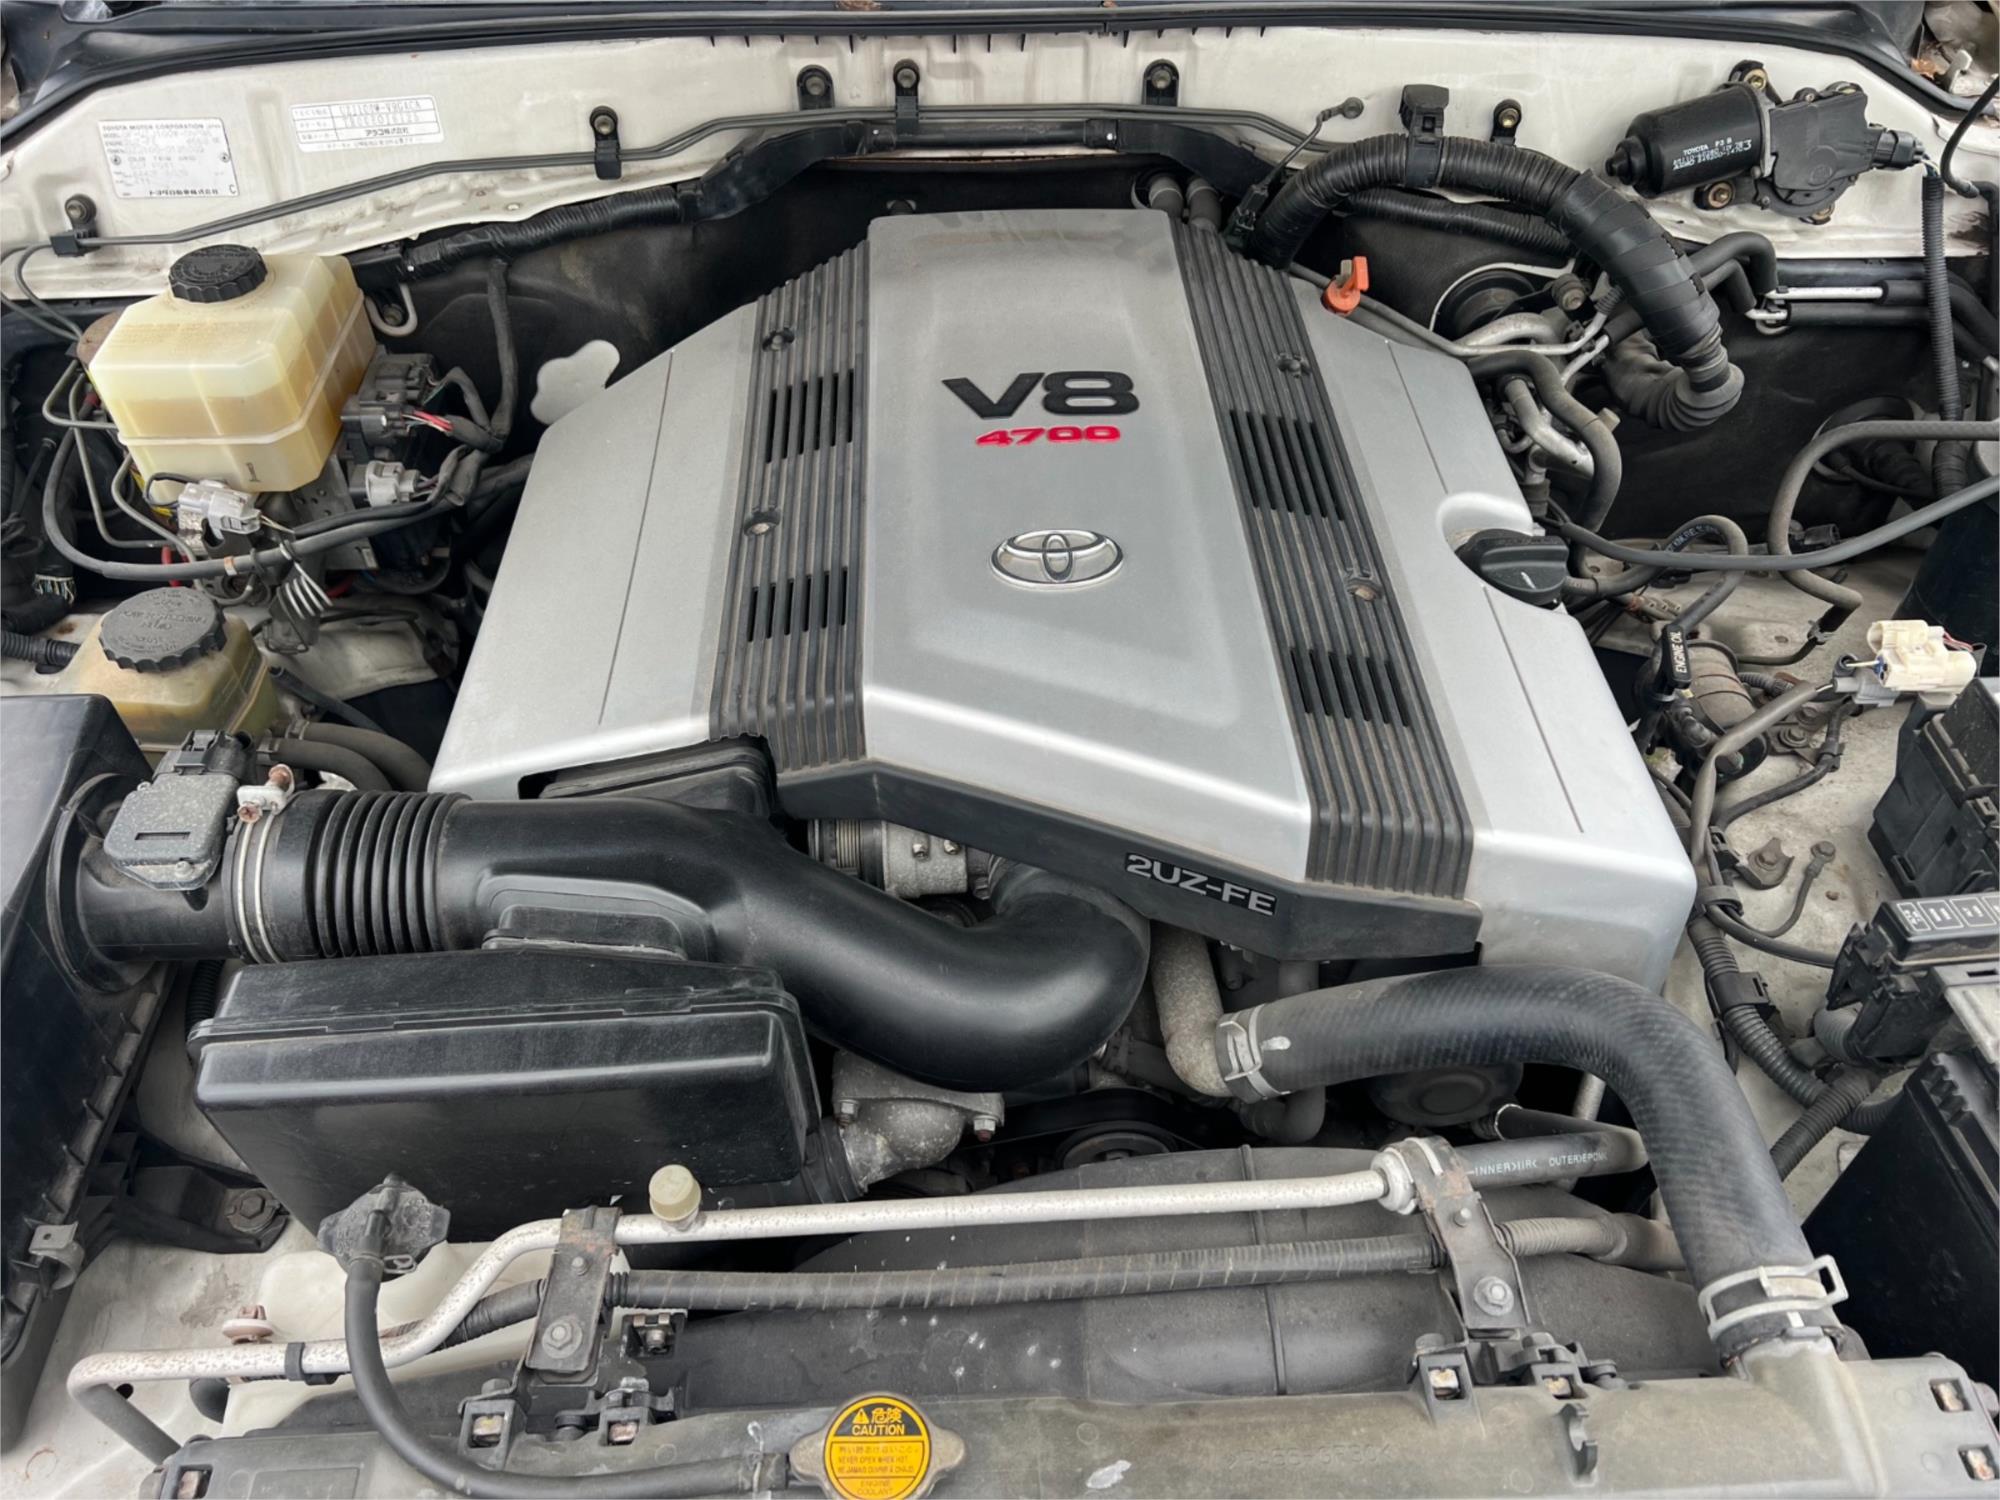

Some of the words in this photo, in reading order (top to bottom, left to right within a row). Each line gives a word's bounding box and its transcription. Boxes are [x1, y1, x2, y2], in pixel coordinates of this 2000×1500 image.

[1683, 144, 1709, 156] TOYOTA
[941, 370, 1140, 420] V8
[975, 425, 1121, 447] 4700
[1672, 643, 1688, 673] ENGINE
[1126, 854, 1276, 916] 2UZ-FE
[871, 1407, 902, 1424] 危険
[852, 1424, 905, 1436] CAUTION
